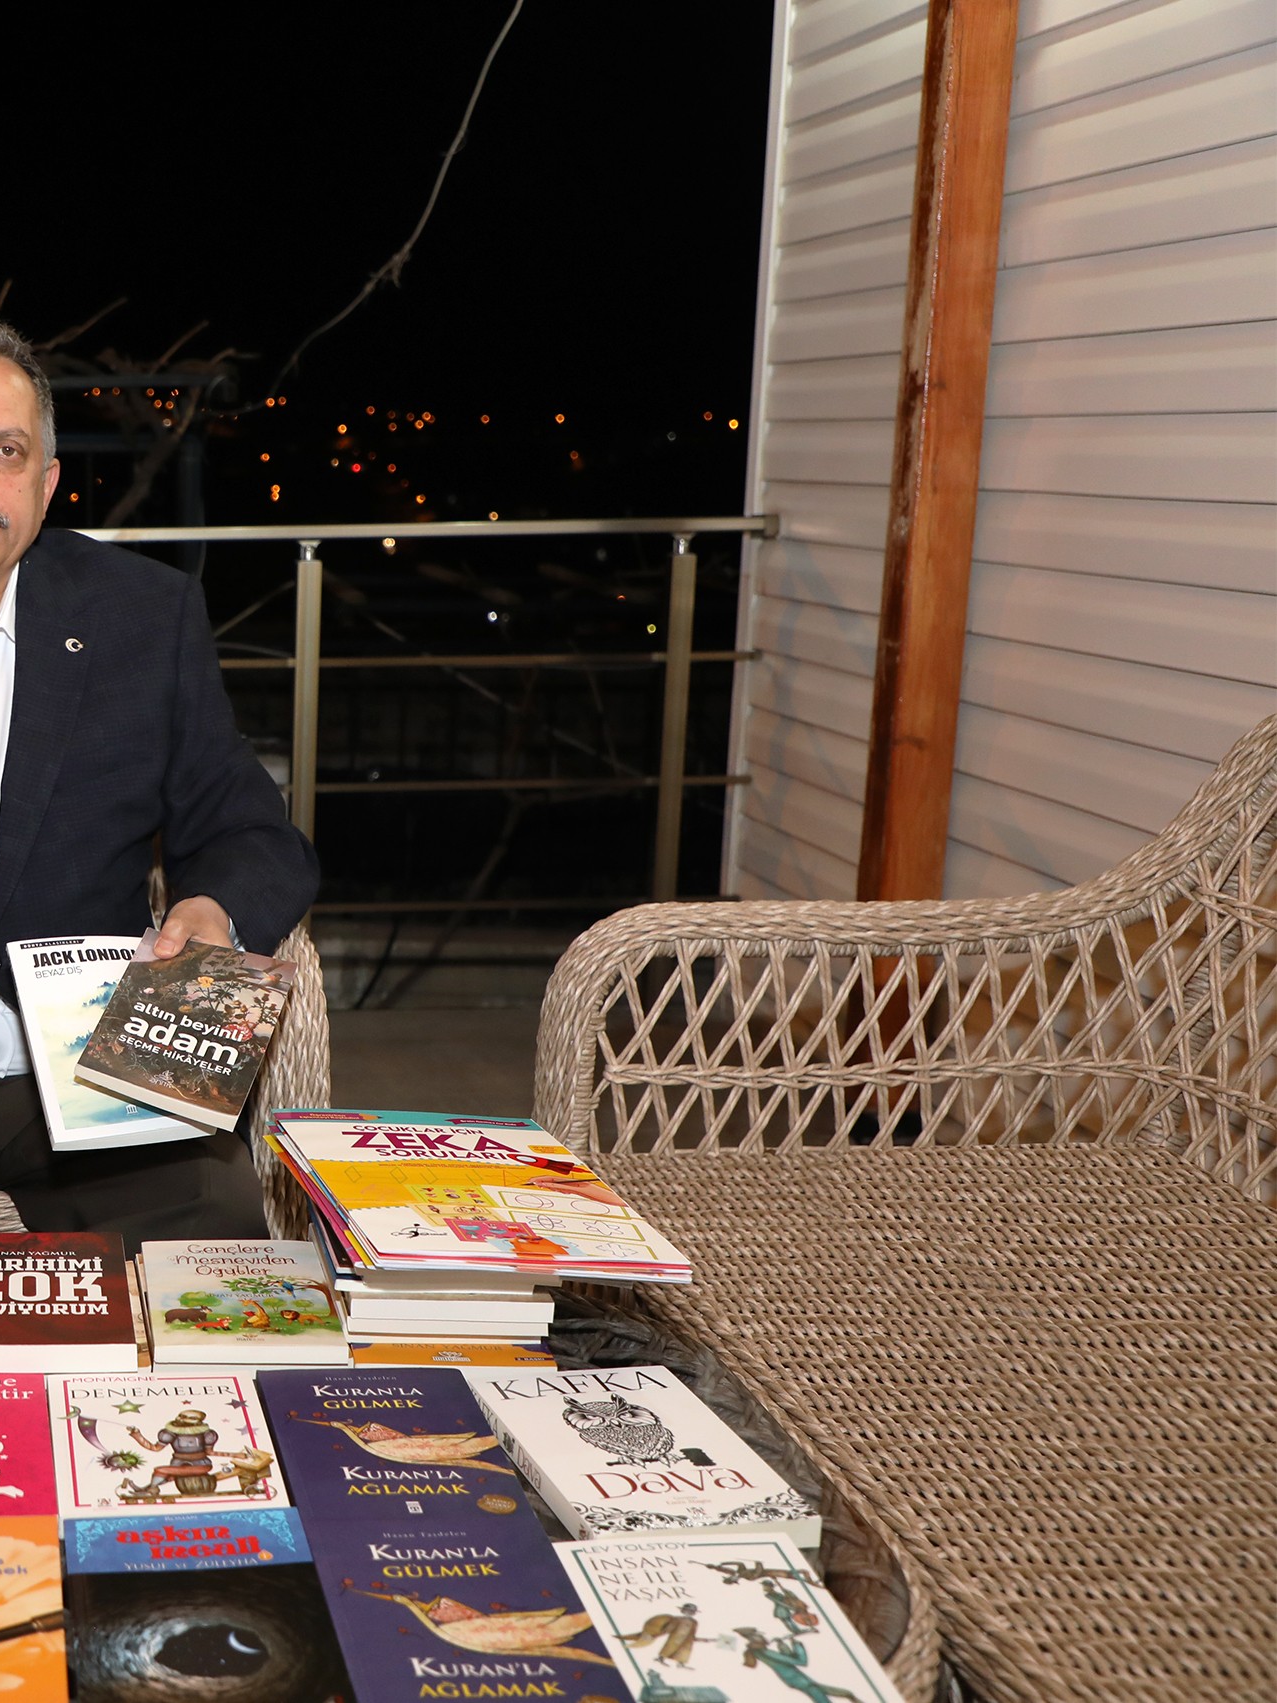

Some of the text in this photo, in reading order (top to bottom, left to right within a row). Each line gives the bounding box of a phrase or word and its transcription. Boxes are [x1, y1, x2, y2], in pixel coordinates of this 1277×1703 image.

[32, 950, 76, 968] JACK
[34, 965, 82, 980] BEYAZ DİŞ
[133, 1001, 246, 1042] altın beyinli
[118, 1034, 162, 1055] SEÇME
[123, 1015, 240, 1066] adam
[342, 1131, 522, 1153] ZEKA
[376, 1148, 508, 1160] SORULARI
[186, 1242, 276, 1256] Gençlere
[172, 1254, 298, 1266] Mesneviden
[70, 1385, 235, 1400] DENEMELER
[312, 1384, 424, 1397] KURAN'LA
[486, 1370, 669, 1401] KAFKA
[322, 1397, 424, 1410] GÜLMEK
[340, 1465, 464, 1481] KURAN'LA
[346, 1482, 470, 1496] AĞLAMAK
[584, 1466, 758, 1500] Dava
[368, 1544, 500, 1561] KURAN'LA
[582, 1542, 688, 1554] LEV TOLSTOY
[382, 1562, 500, 1579] GÜLMEK
[588, 1555, 678, 1572] İNSAN
[597, 1570, 688, 1588] NE İLE
[602, 1586, 696, 1602] YAŞAR
[410, 1656, 556, 1678] KURAN'LA
[420, 1679, 567, 1699] AĞLAMAK
